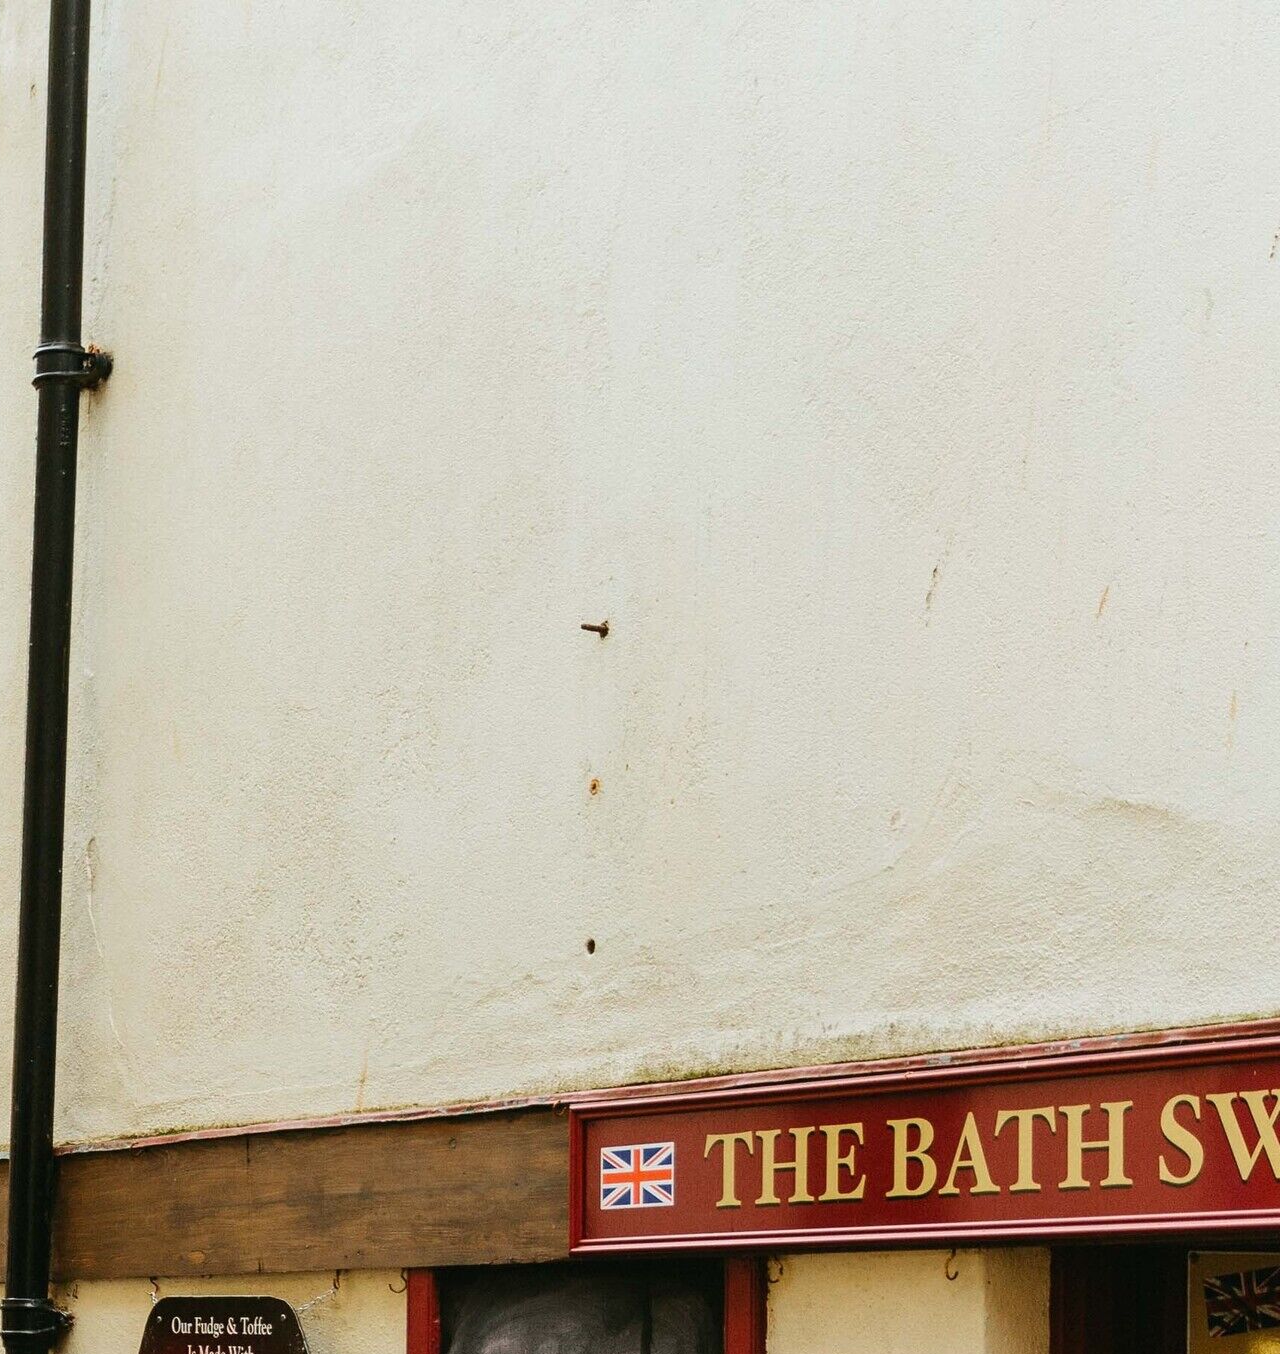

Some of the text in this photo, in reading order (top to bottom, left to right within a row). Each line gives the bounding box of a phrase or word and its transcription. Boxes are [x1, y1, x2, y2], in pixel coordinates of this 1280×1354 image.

[703, 1122, 867, 1209] THE
[885, 1100, 1135, 1198] BATH
[171, 1316, 273, 1338] Our Fudge & Toffee
